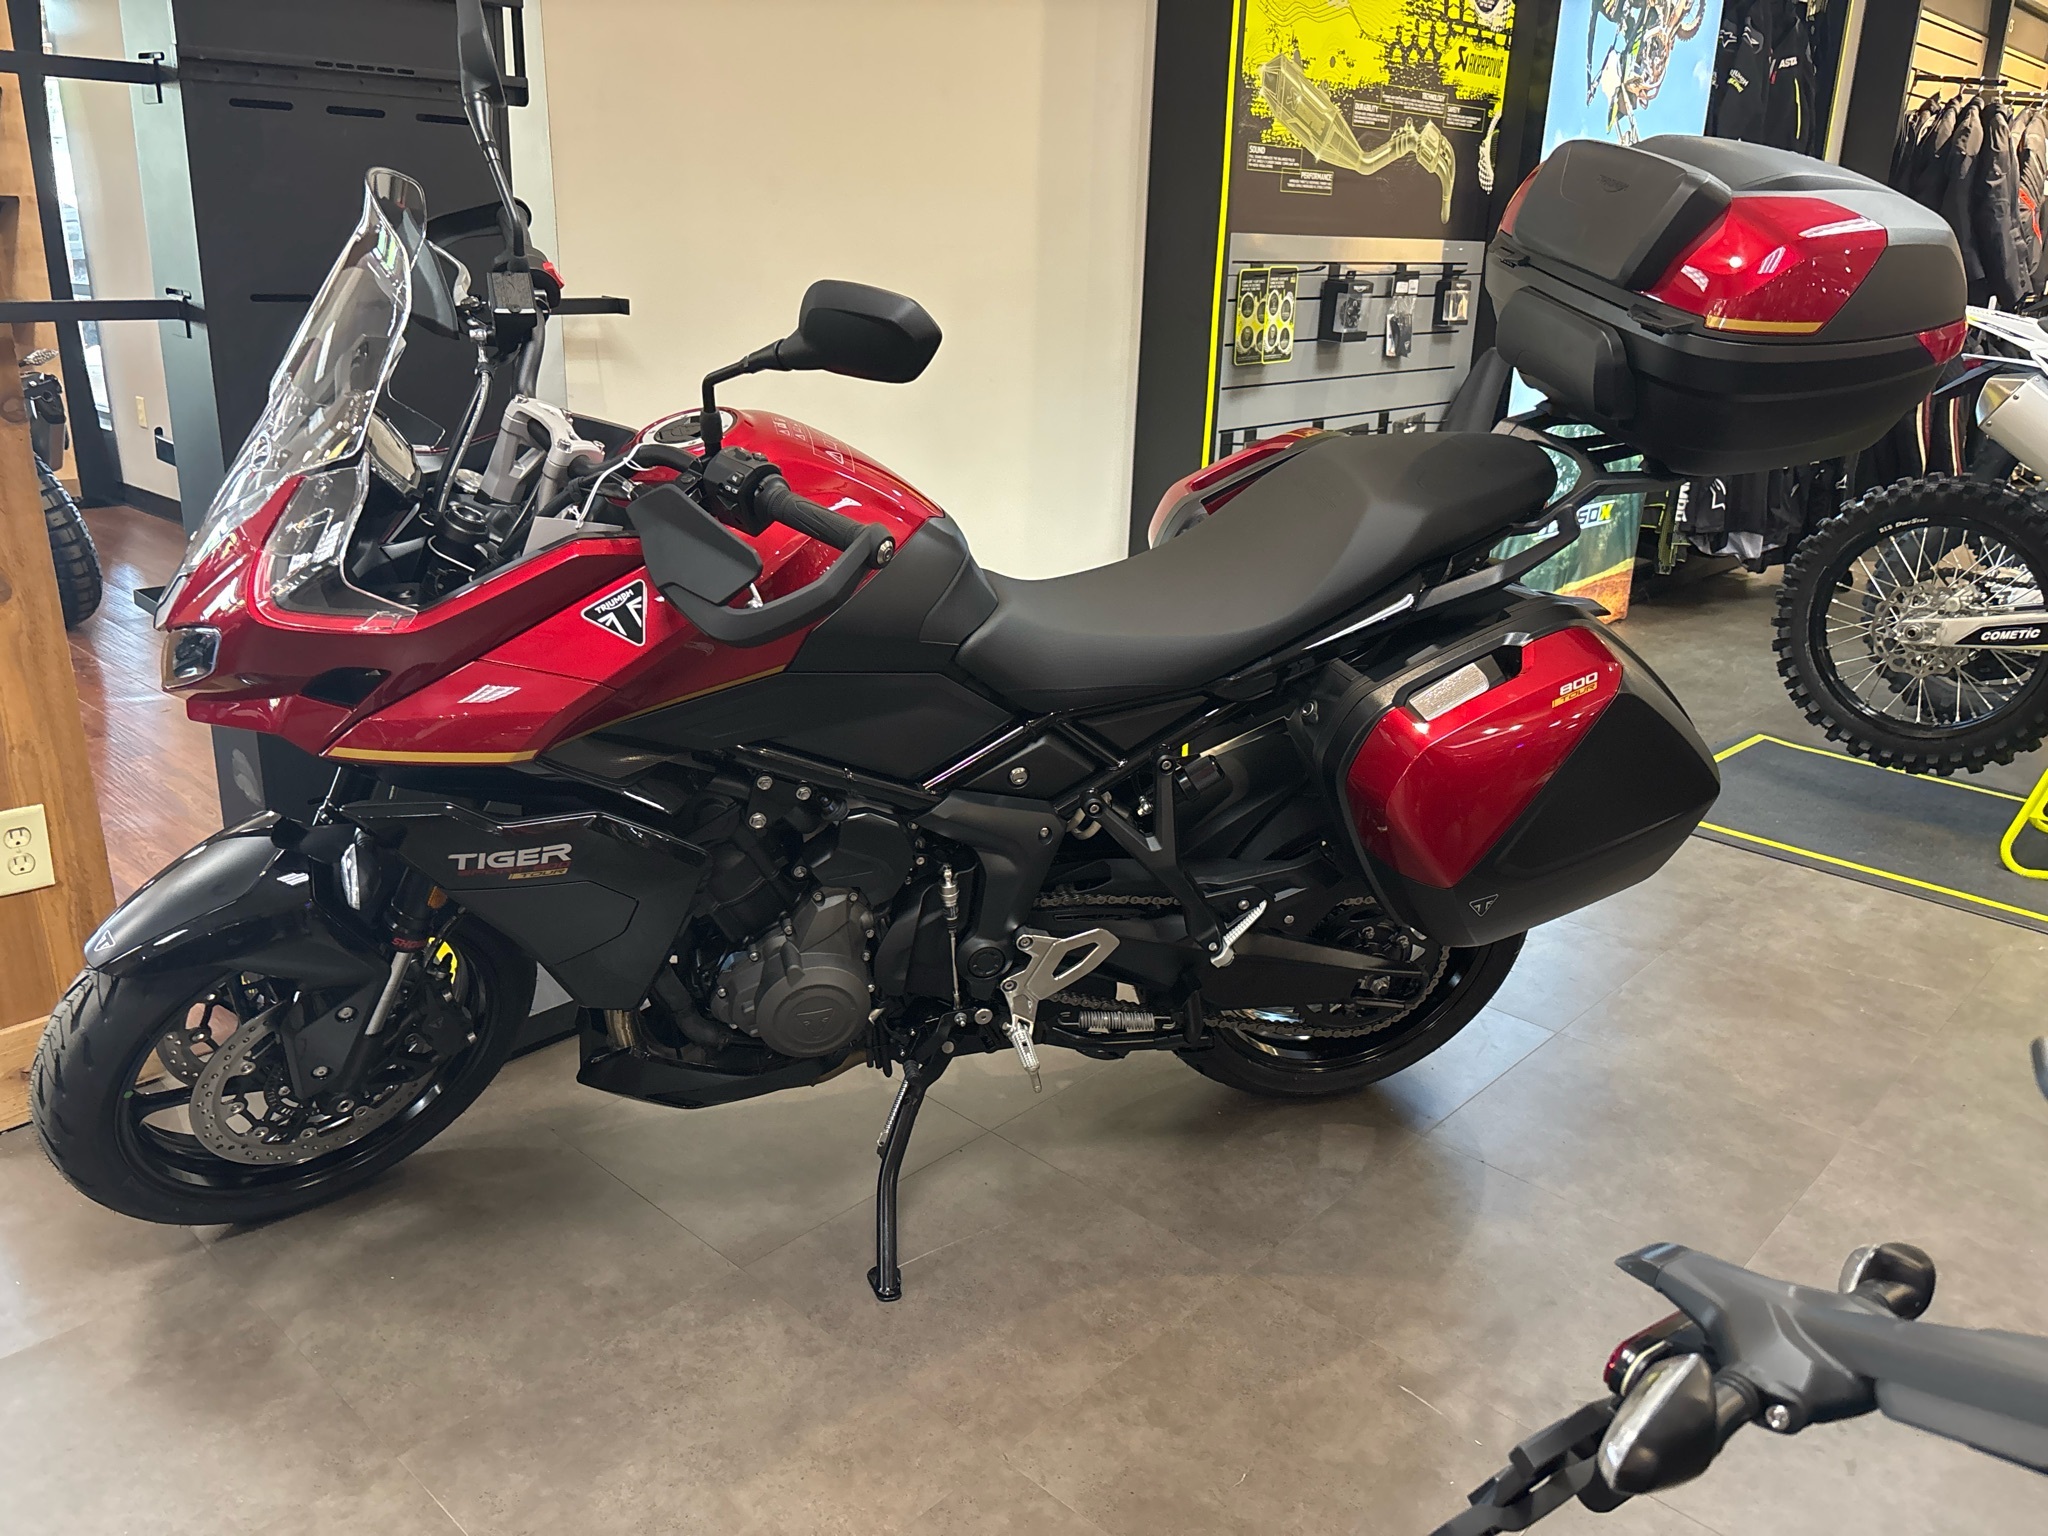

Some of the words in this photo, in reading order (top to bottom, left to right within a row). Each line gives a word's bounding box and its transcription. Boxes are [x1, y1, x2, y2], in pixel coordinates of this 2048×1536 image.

[1249, 145, 1266, 154] SOUND
[1300, 171, 1334, 181] PERFORMANCE
[594, 588, 635, 614] TRIUMPH
[1559, 671, 1598, 696] 800
[1560, 683, 1596, 702] TOUR
[447, 843, 572, 870] TIGER
[520, 868, 567, 879] TOUR
